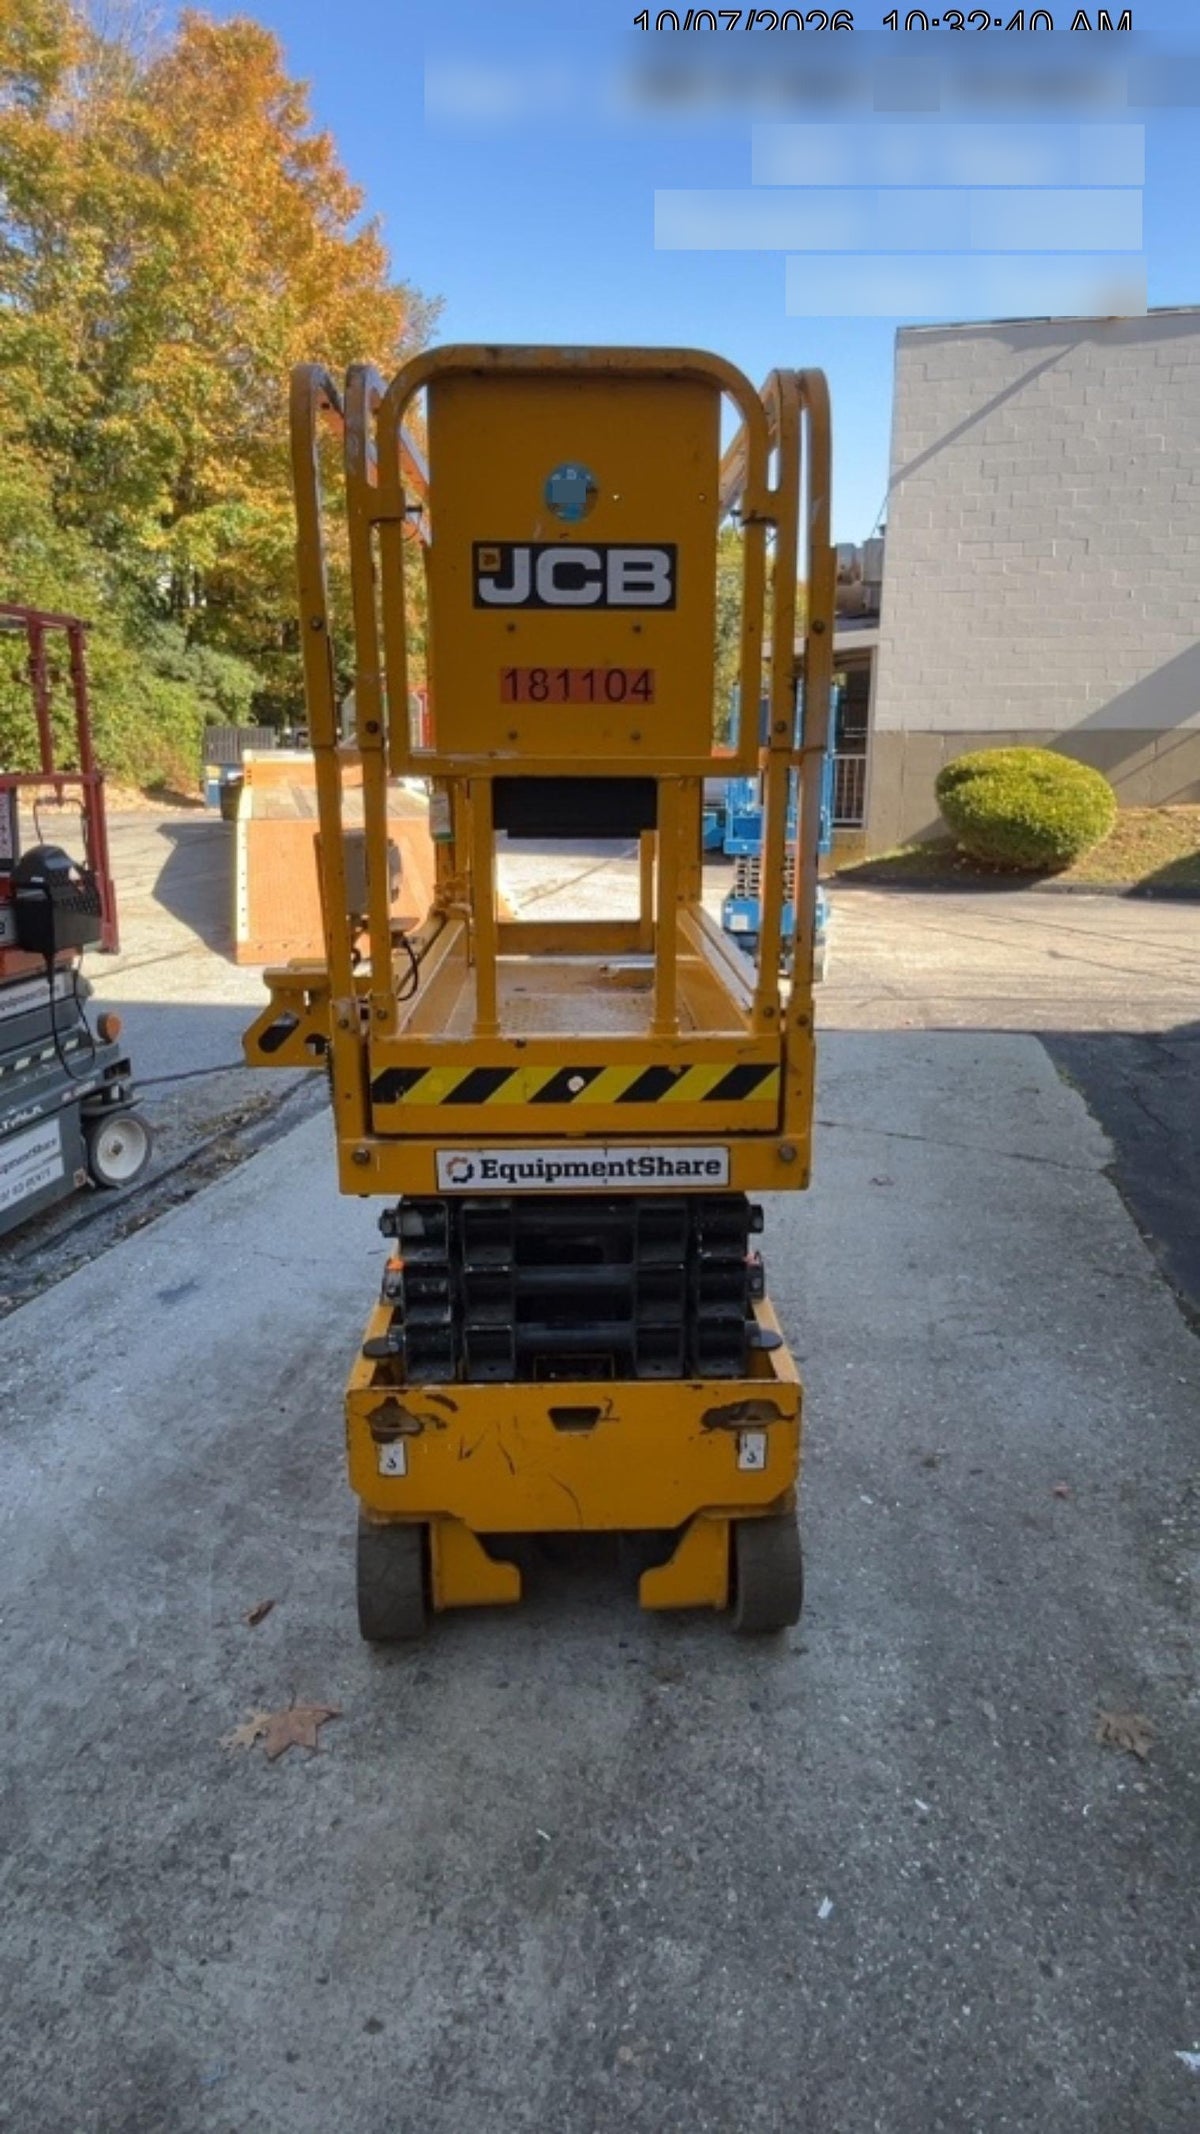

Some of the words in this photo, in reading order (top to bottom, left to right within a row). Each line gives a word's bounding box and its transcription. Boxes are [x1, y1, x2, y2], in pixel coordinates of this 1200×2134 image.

[478, 547, 672, 605] JCB
[504, 668, 652, 702] 181104
[480, 1156, 722, 1184] EquipmentShare
